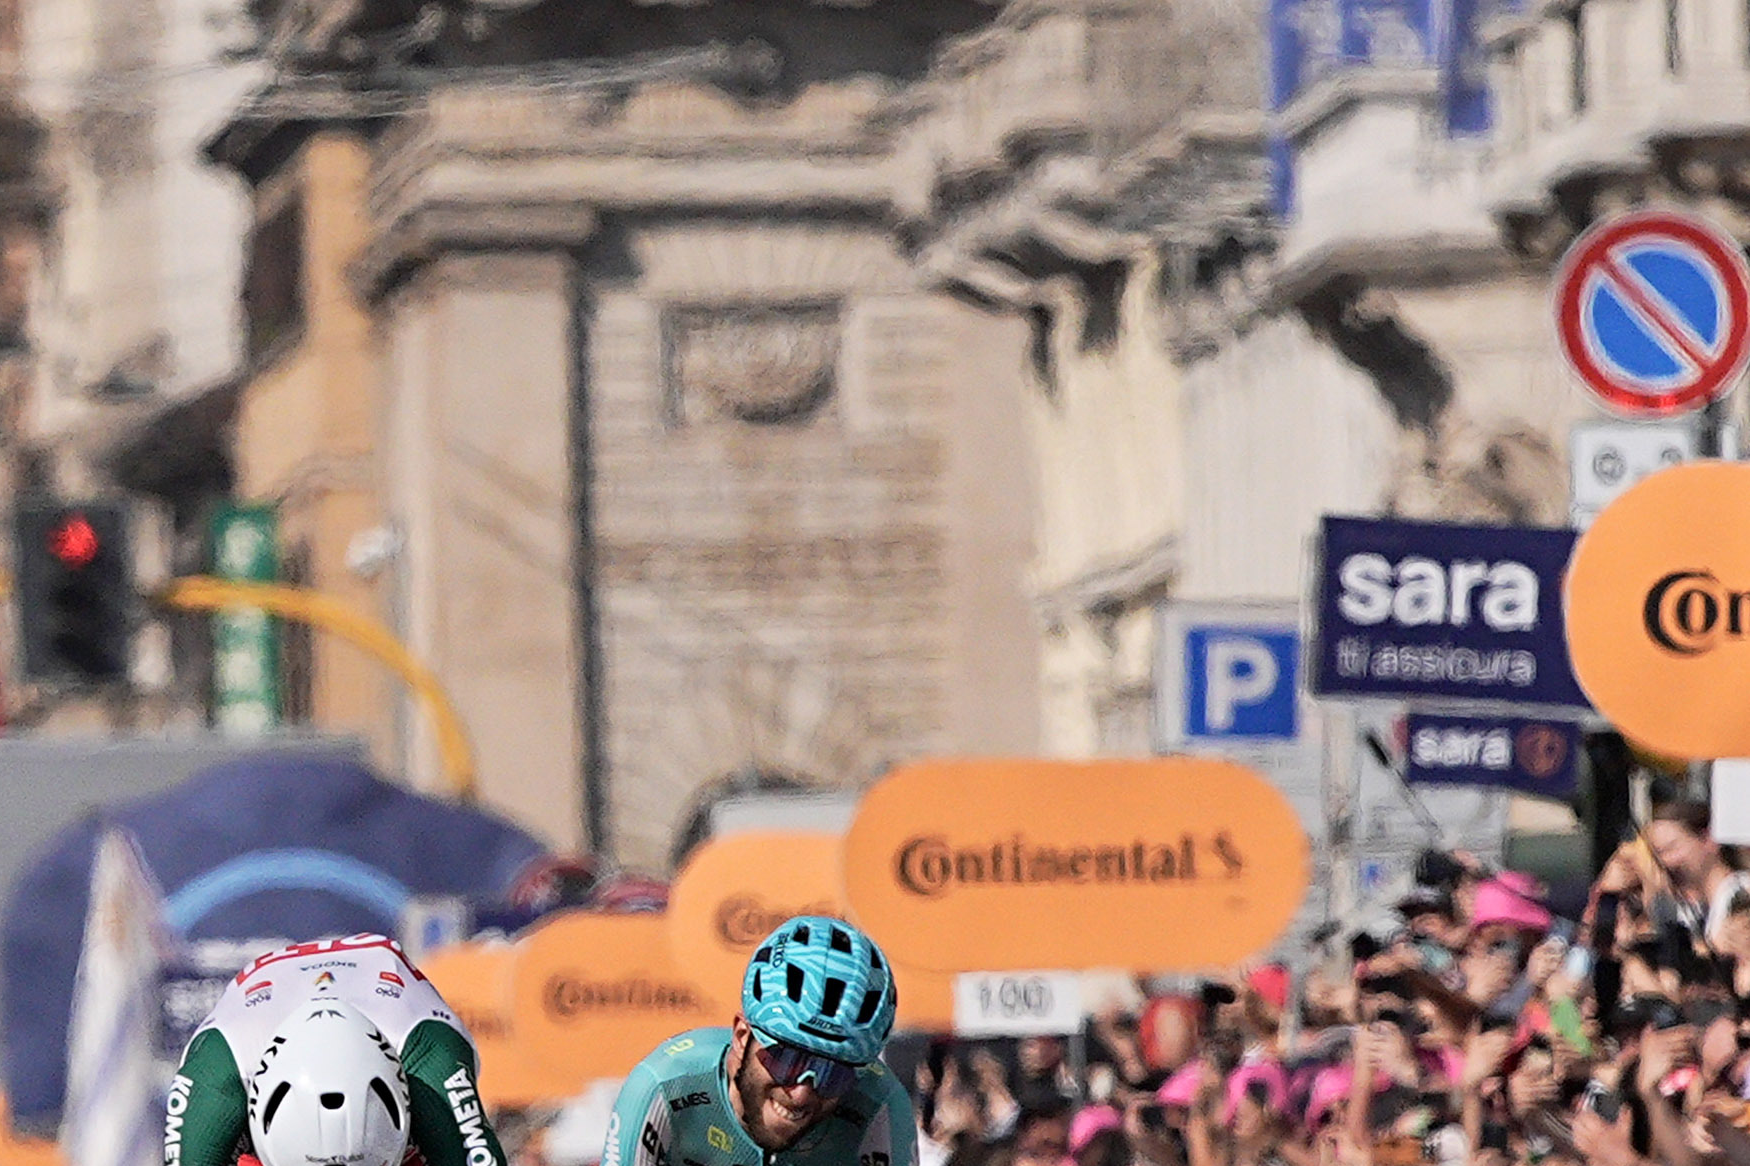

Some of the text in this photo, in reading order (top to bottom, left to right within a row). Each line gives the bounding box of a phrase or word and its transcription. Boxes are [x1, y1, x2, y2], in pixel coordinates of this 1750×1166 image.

[1337, 551, 1541, 633] sara
[1206, 637, 1279, 731] P
[1411, 727, 1513, 771] sara
[895, 834, 1197, 898] Continental
